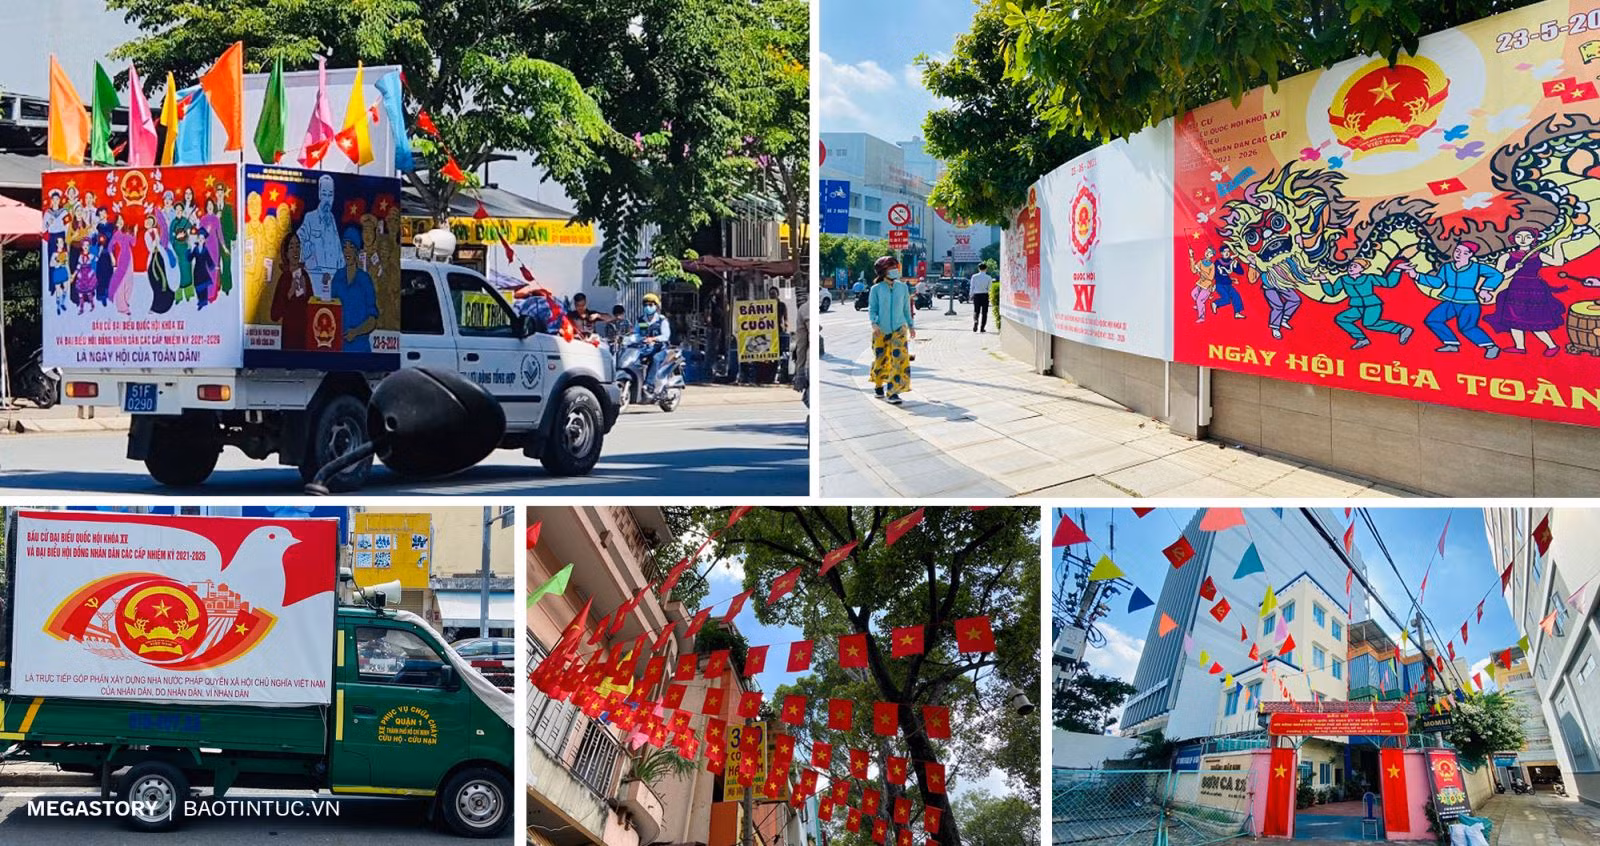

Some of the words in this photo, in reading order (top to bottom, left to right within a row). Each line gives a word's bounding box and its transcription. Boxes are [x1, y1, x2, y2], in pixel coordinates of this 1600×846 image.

[1270, 109, 1280, 120] XV
[1270, 128, 1288, 140] CẤP
[1385, 136, 1400, 144] NAM
[1238, 149, 1258, 160] 2026
[516, 222, 548, 242] DÂN
[1072, 284, 1096, 314] XV
[740, 302, 774, 316] BÁNH
[741, 316, 774, 330] CUỐN
[76, 348, 87, 362] LÀ
[89, 348, 113, 362] NGÀY
[116, 348, 130, 365] HỘI
[132, 346, 150, 362] CỦA
[152, 348, 176, 362] TOÀN
[1208, 344, 1276, 366] NGÀY
[1285, 353, 1345, 378] HỘI
[1359, 360, 1440, 390] CỦA
[1456, 374, 1600, 412] TOÀN
[132, 384, 150, 398] 51F
[128, 398, 153, 410] 0290
[27, 528, 39, 542] BẦU
[40, 528, 49, 542] CỬ
[50, 532, 60, 544] ĐẠI
[61, 528, 74, 542] BIỂU
[76, 530, 91, 543] QUỐC
[92, 532, 102, 545] HỘI
[104, 532, 118, 544] KHÓA
[120, 534, 128, 544] XV
[27, 545, 34, 556] VÀ
[36, 547, 46, 559] ĐẠI
[48, 544, 60, 557] BIỂU
[62, 546, 72, 559] HỘI
[73, 545, 88, 557] ĐỒNG
[90, 546, 106, 558] NHÂN
[108, 547, 120, 558] DÂN
[122, 547, 132, 558] CÁC
[134, 546, 146, 559] CẤP
[147, 548, 166, 562] NHIỆM
[167, 548, 174, 560] KỲ
[176, 551, 206, 560] 2021-2026
[25, 674, 34, 682] LÀ
[36, 674, 54, 684] TRỰC
[56, 674, 71, 682] TIẾP
[73, 674, 88, 682] GÓP
[90, 674, 108, 683] PHẦN
[111, 675, 124, 684] XÂY
[126, 676, 145, 685] DỰNG
[148, 676, 162, 684] NHÀ
[164, 675, 183, 684] NƯỚC
[185, 676, 203, 684] PHÁP
[205, 676, 228, 686] QUYỀN
[230, 676, 239, 686] XÃ
[241, 677, 253, 688] HỘI
[255, 676, 269, 686] CHỦ
[271, 678, 292, 687] NGHĨA
[294, 678, 308, 688] VIỆT
[311, 680, 326, 688] NAM
[101, 685, 115, 695] CỦA
[117, 686, 136, 695] NHÂN
[168, 687, 186, 696] NHÂN
[206, 686, 213, 696] VÌ
[214, 688, 233, 697] NHÂN
[234, 689, 249, 698] DÂN
[396, 717, 416, 727] QUẬN
[393, 736, 402, 744] HỘ
